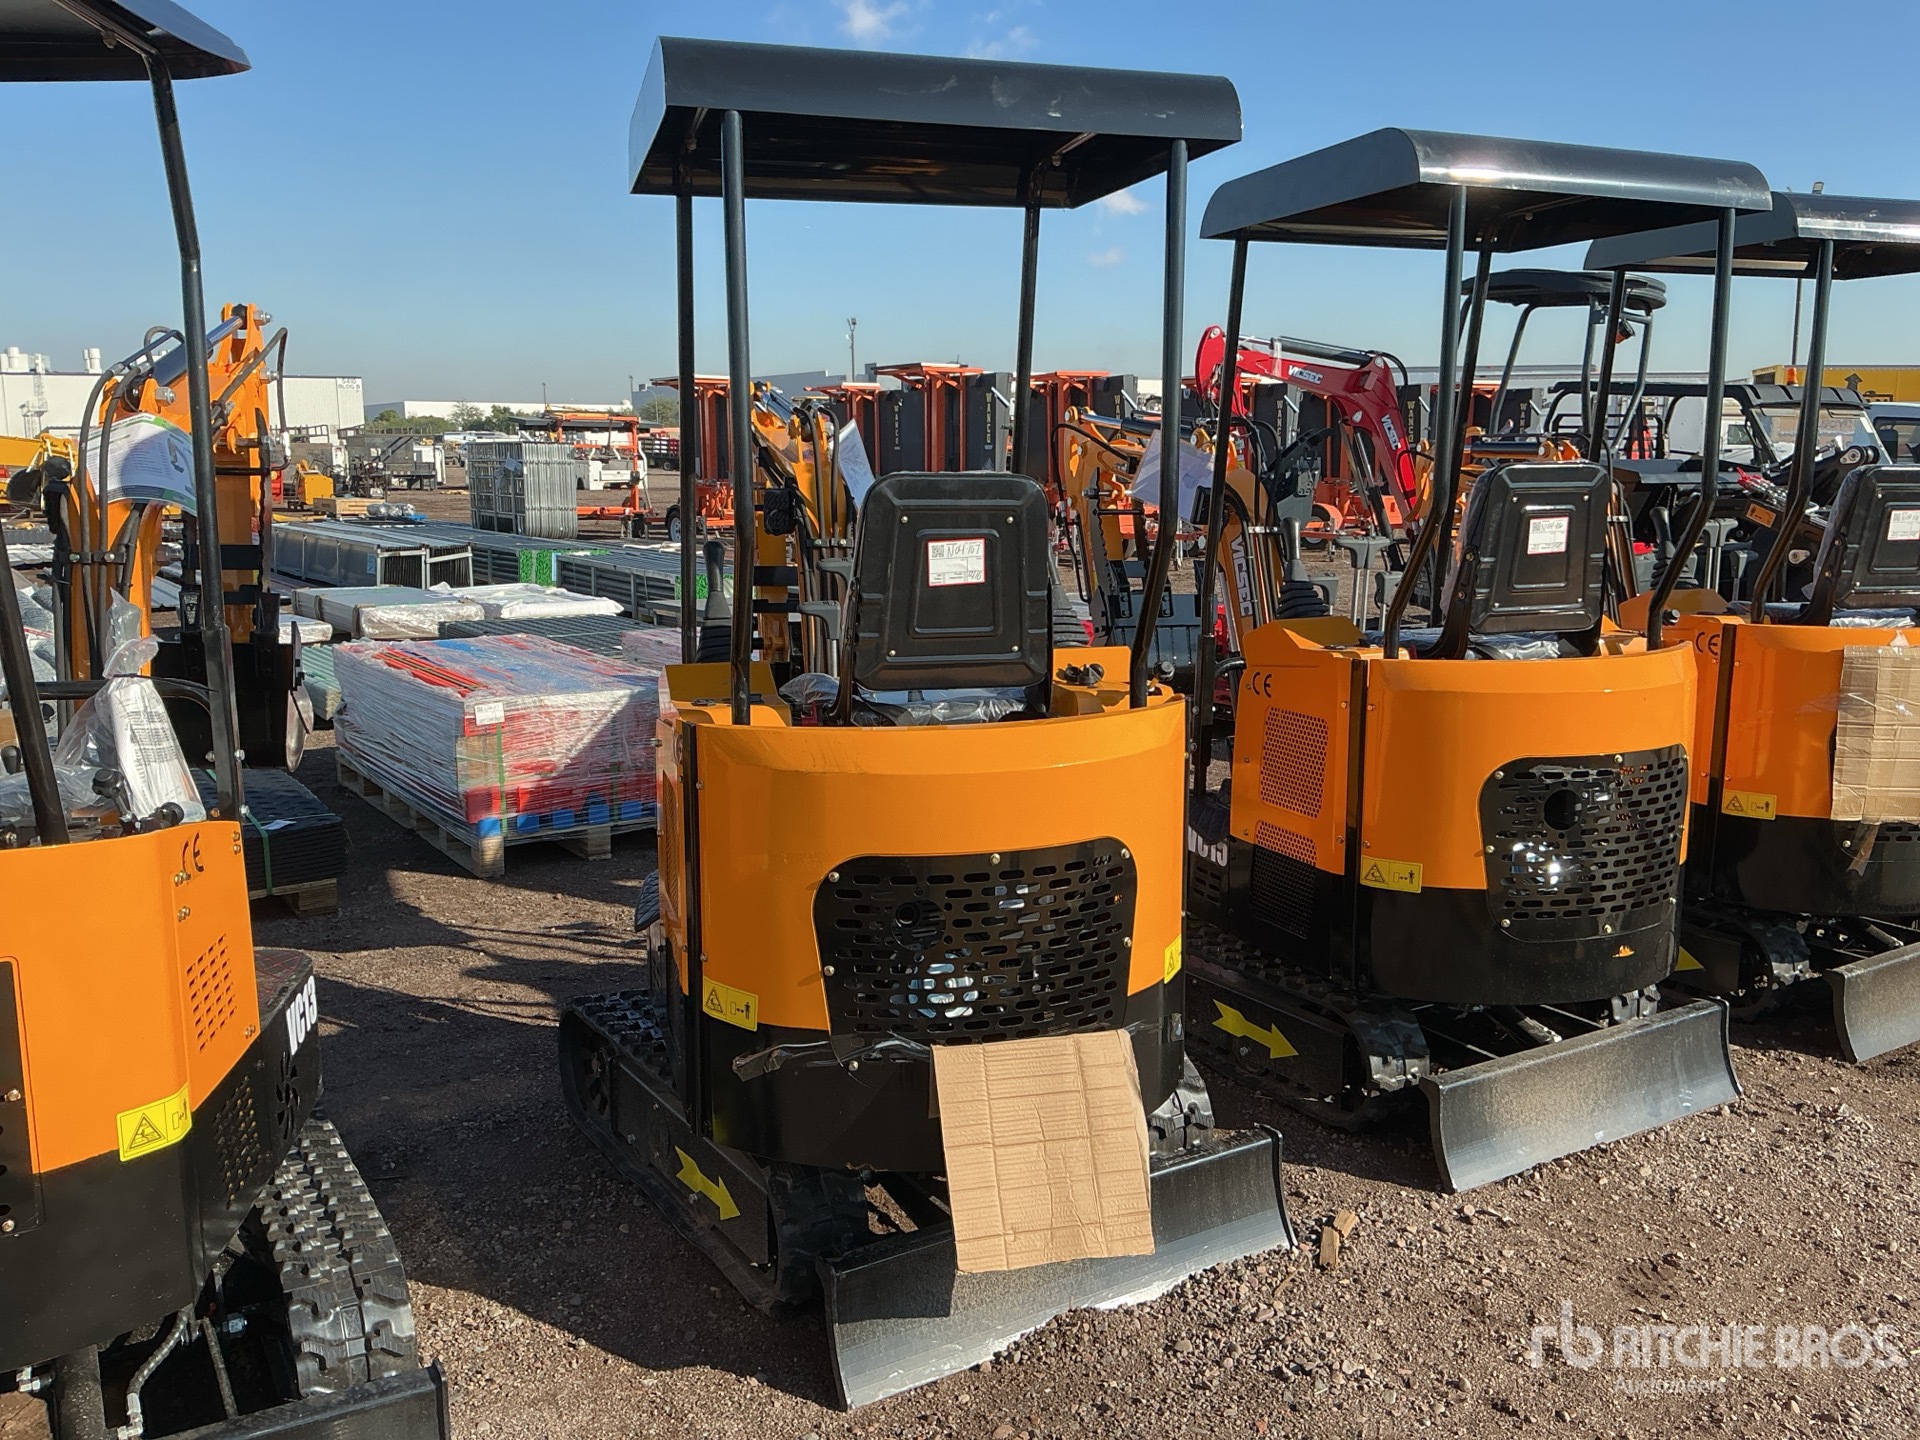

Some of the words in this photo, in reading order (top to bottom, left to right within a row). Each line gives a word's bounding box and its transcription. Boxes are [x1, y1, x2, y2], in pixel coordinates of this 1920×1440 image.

[1288, 364, 1323, 385] VICSEC
[985, 392, 993, 443] WANCO
[1381, 414, 1402, 450] VICSEC
[1407, 401, 1415, 443] WANCO
[1230, 533, 1253, 617] VICSEC
[1695, 631, 1720, 656] CE
[1252, 671, 1272, 698] CE
[181, 832, 204, 879] CE
[285, 975, 318, 1056] VC13
